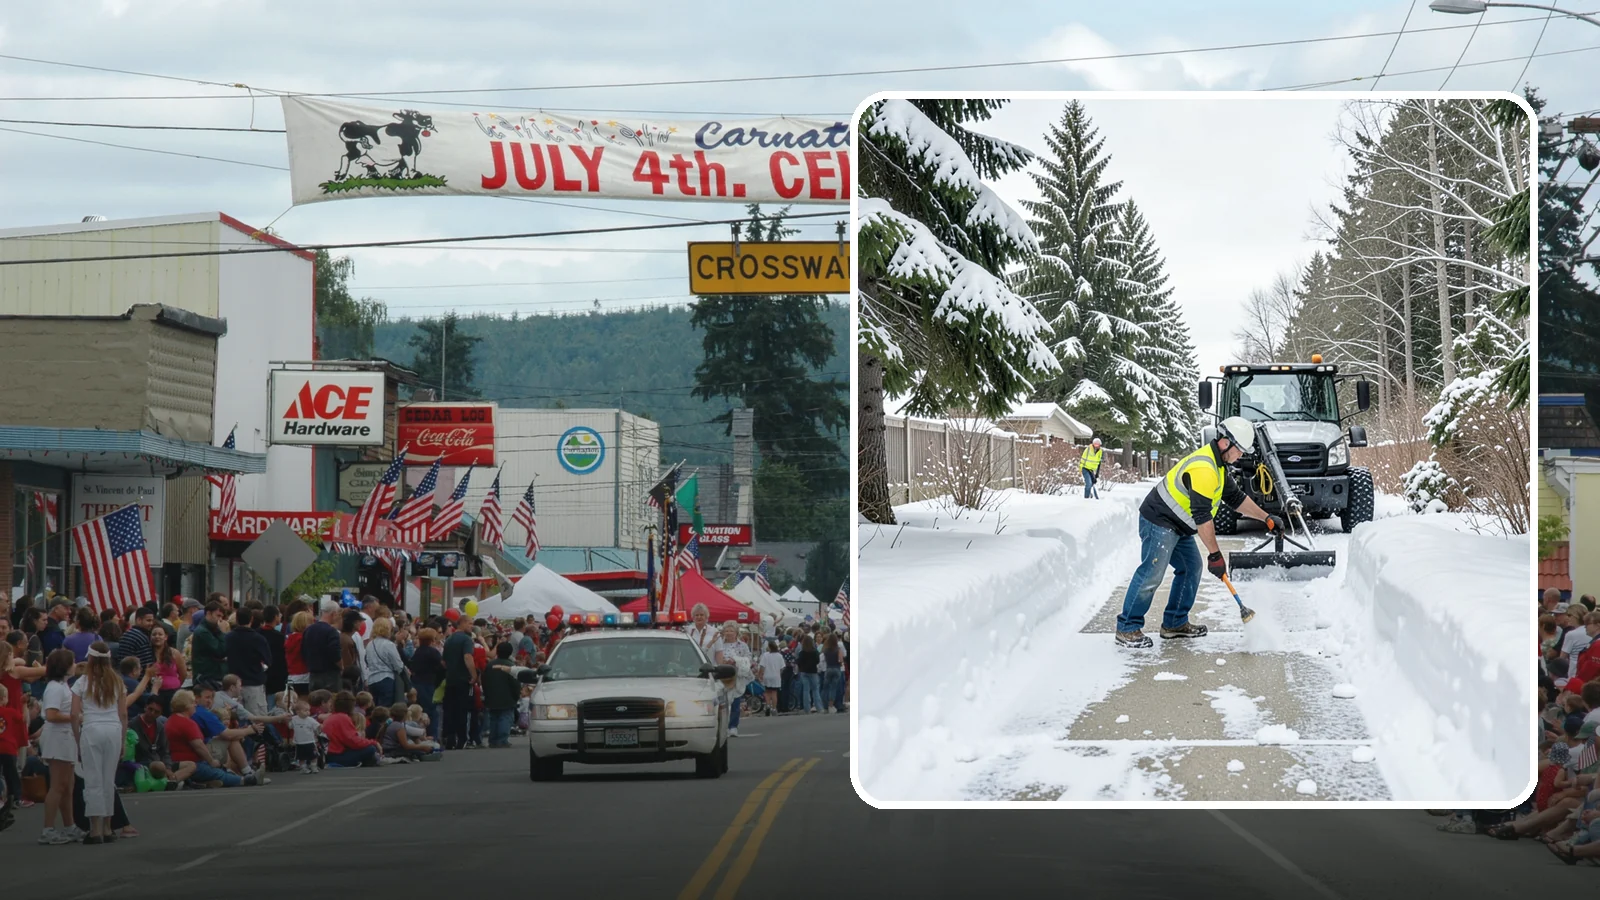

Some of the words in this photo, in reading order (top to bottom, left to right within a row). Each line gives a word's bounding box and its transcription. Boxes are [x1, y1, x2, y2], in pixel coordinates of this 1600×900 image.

[481, 141, 605, 192] JULY
[632, 149, 746, 198] 4th.
[697, 254, 850, 280] CROSSWA
[283, 380, 373, 420] ACE
[406, 409, 452, 421] CEDAR
[461, 409, 485, 421] LOG
[283, 421, 371, 436] Hardware
[353, 467, 385, 481] Simpl
[95, 485, 124, 495] Vincent
[126, 486, 135, 495] de
[138, 486, 155, 495] Paul
[688, 526, 742, 535] CRNATION
[699, 535, 730, 543] GLASS
